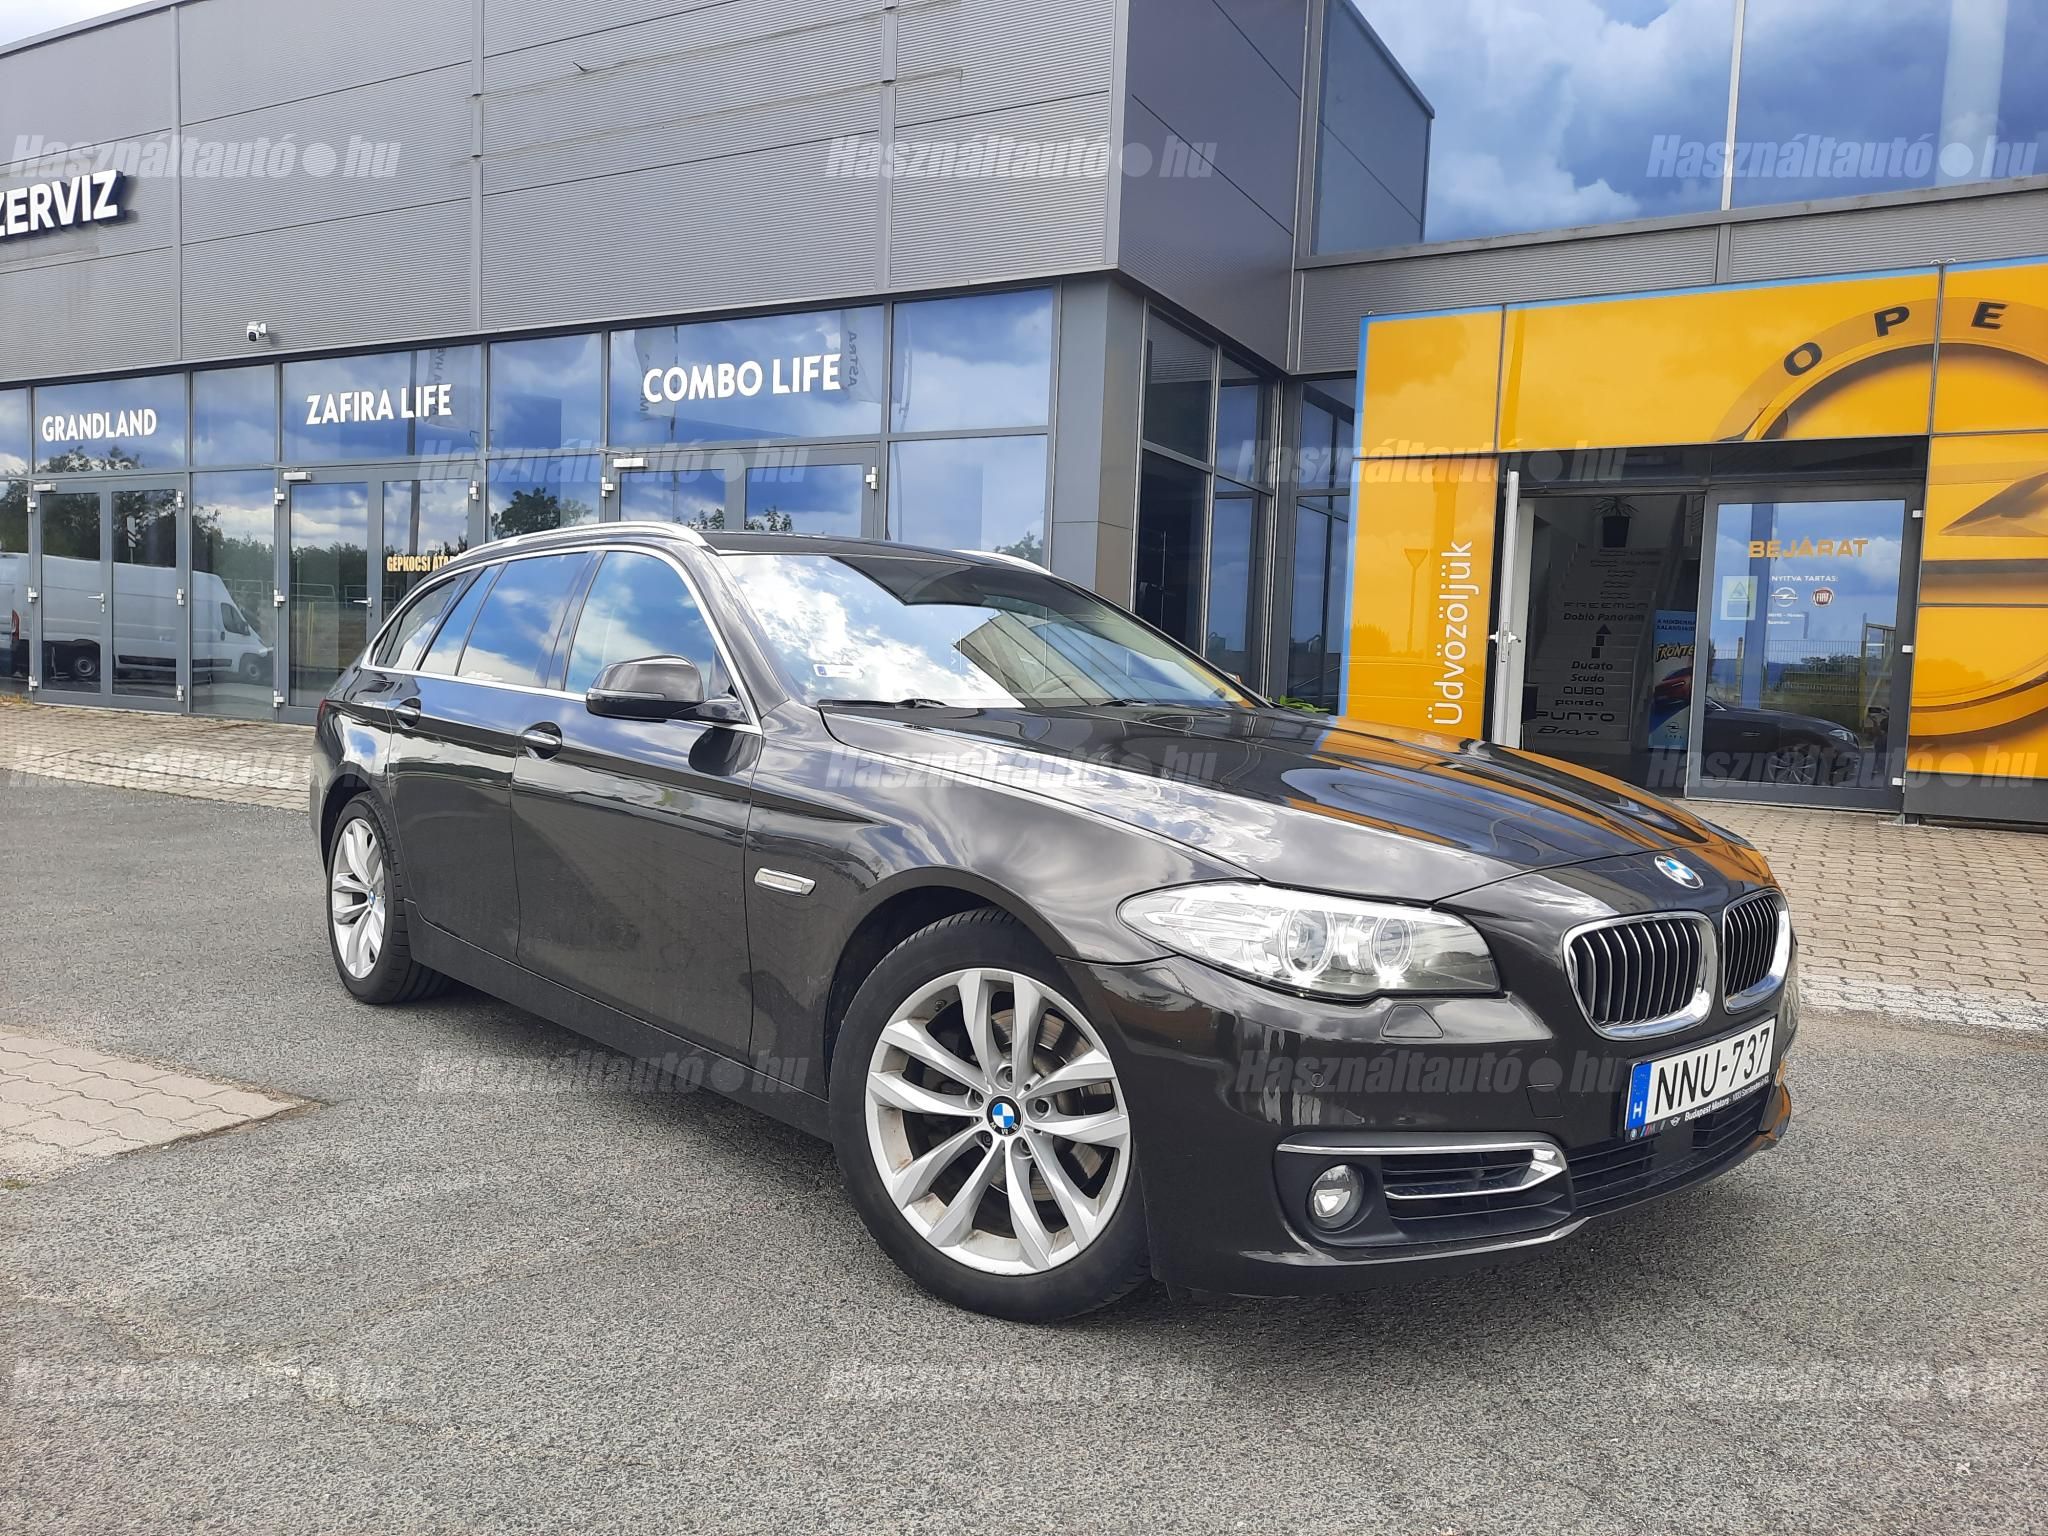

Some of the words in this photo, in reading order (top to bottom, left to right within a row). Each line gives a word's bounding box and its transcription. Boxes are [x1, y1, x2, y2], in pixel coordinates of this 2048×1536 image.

[0, 169, 118, 236] ERVIZ
[643, 360, 763, 403] COMBO
[772, 353, 841, 394] LIFE
[305, 389, 394, 425] ZAFIRA
[400, 383, 452, 419] LIFE
[42, 408, 157, 442] GRANDLAND
[1748, 537, 1869, 558] BEJÁRAT
[386, 553, 431, 572] GÉPKOCSI
[1427, 541, 1480, 725] Üdvözöljük
[1571, 661, 1613, 671] Ducato
[1570, 673, 1605, 683] Scudo
[1537, 725, 1600, 736] Bravo
[1654, 1027, 1770, 1115] NNU-737
[1632, 1100, 1643, 1120] H
[1684, 1104, 1712, 1122] Budapest
